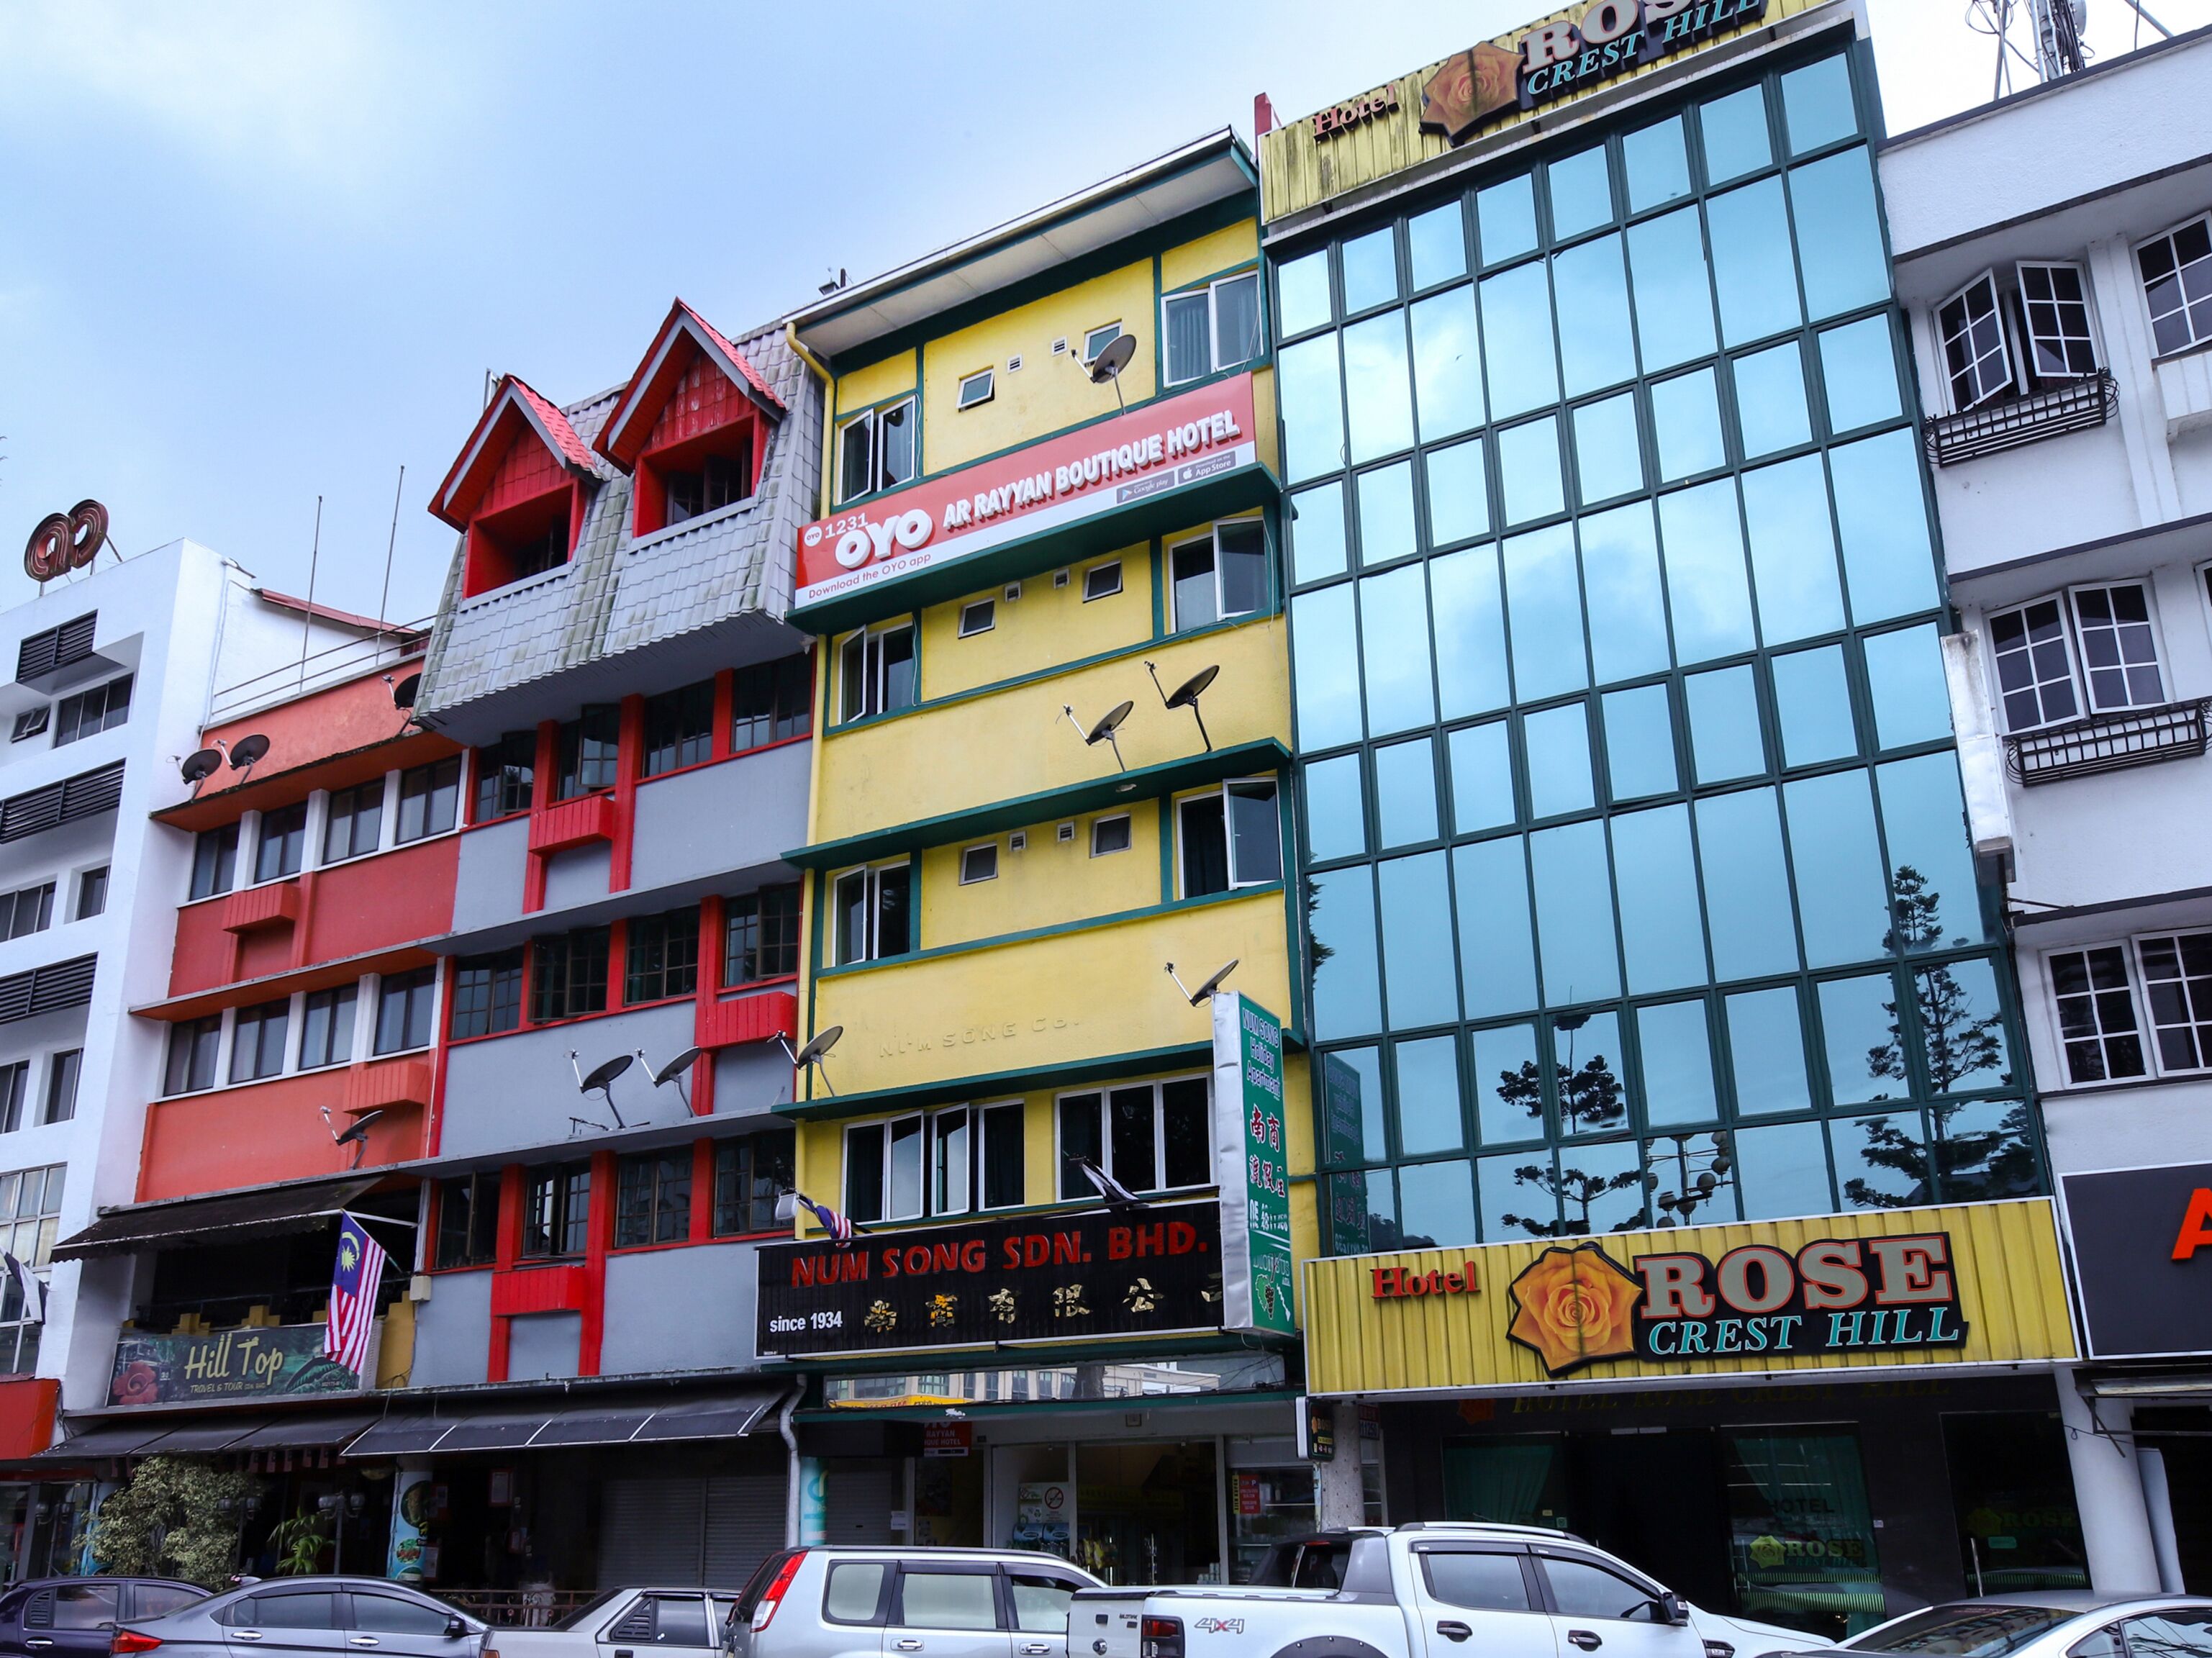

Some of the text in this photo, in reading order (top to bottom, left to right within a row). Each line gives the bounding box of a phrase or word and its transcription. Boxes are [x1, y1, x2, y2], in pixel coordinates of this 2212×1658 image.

[1527, 0, 1760, 95] CREST HILL
[1313, 84, 1399, 137] Hotel
[943, 409, 1240, 529] AR RAYYAN BOUTIQUE HOTEL
[1133, 481, 1155, 494] Google
[1156, 479, 1169, 489] play
[1195, 459, 1231, 477] App Store
[806, 532, 820, 541] OYO
[825, 512, 868, 539] 1231
[835, 509, 933, 569] OYO
[809, 554, 931, 599] Download the OYO app
[1242, 1007, 1279, 1048] NUM SONG
[1249, 1036, 1274, 1074] Holiday
[792, 1220, 1207, 1289] NUM SONG SDN. BHD.
[1369, 1261, 1481, 1299] Hotel
[1636, 1236, 1953, 1319] ROSE
[769, 1310, 843, 1333] since 1934
[1649, 1307, 1959, 1355] CREST HILL
[183, 1332, 284, 1385] Hill Top
[224, 1381, 243, 1391] TOUR
[1770, 1498, 1836, 1513] HOTEL
[1785, 1540, 1864, 1557] ROSE
[1194, 1617, 1245, 1634] 4x4
